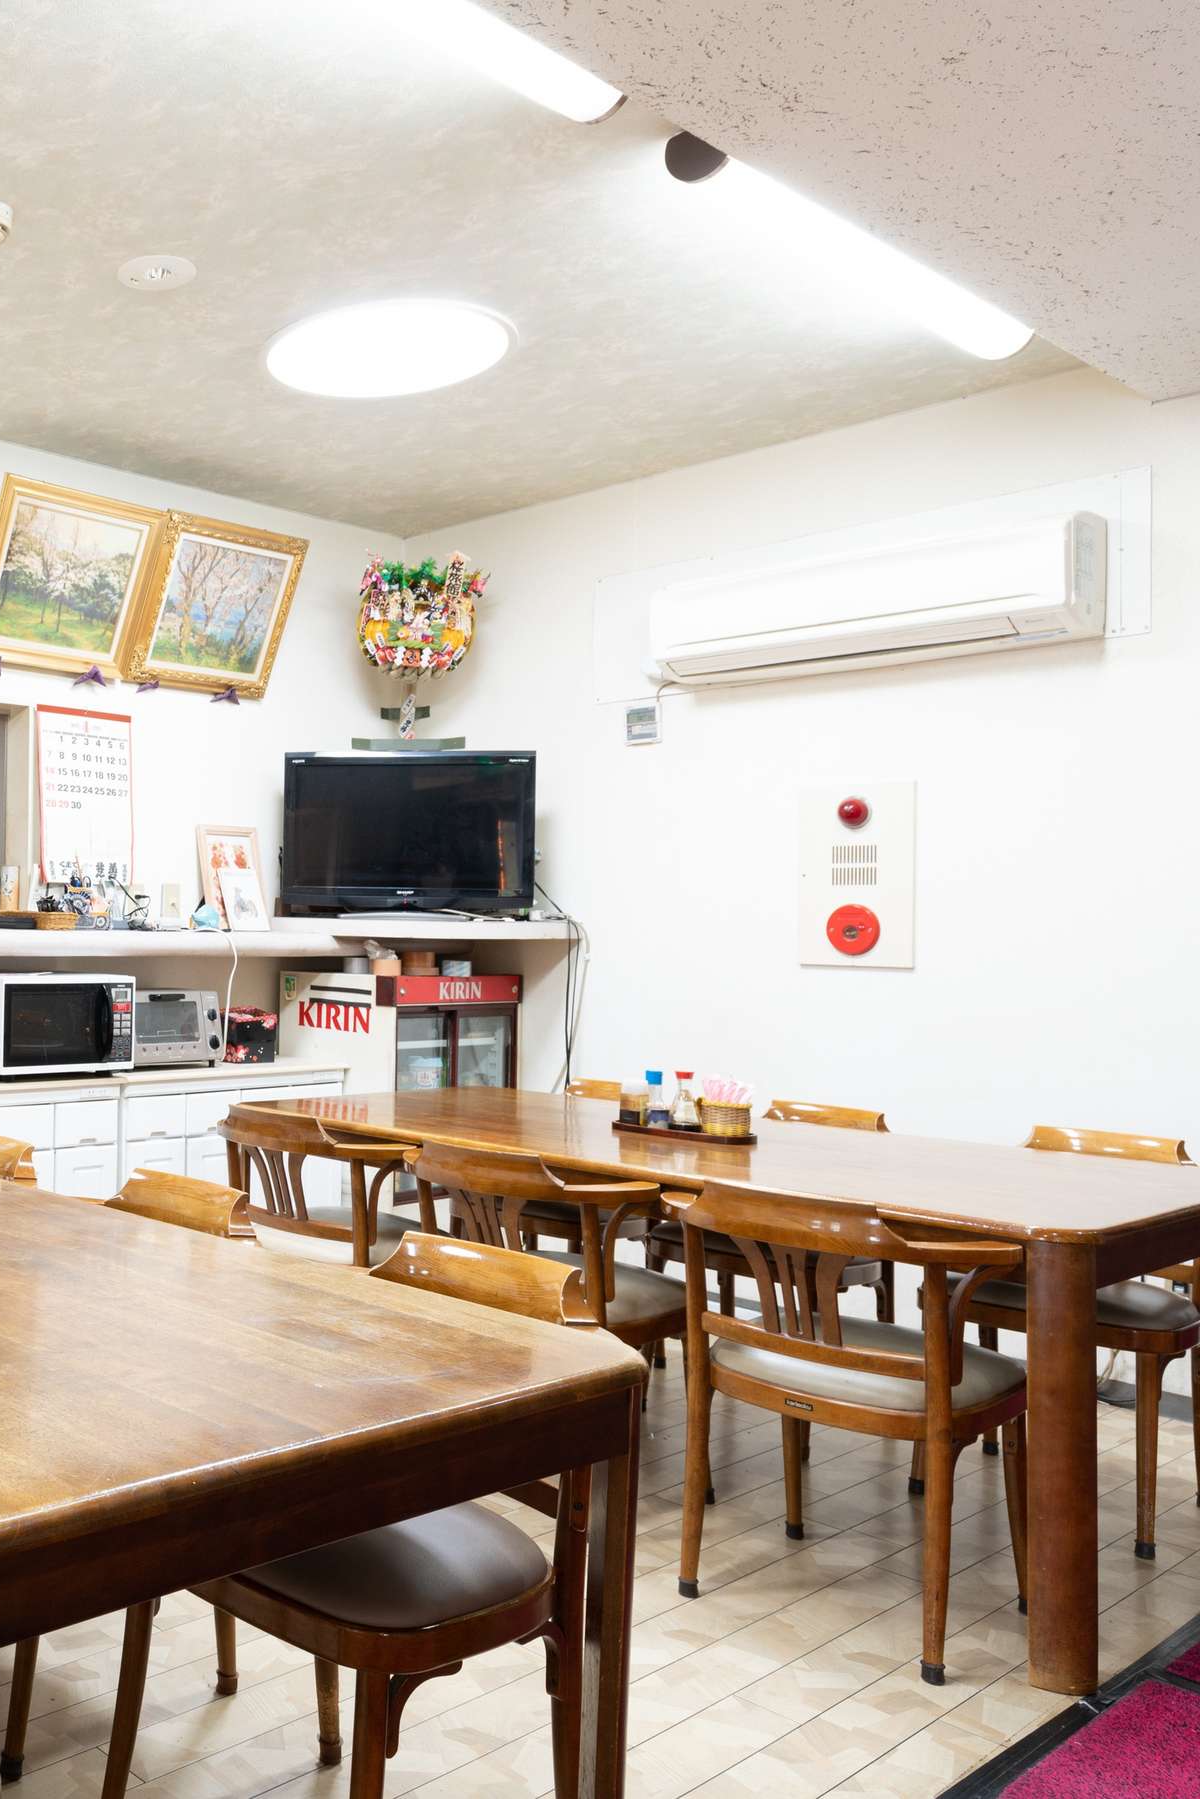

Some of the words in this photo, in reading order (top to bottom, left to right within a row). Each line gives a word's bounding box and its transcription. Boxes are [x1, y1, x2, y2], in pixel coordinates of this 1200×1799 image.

[59, 735, 64, 743] 1
[71, 736, 78, 745] 2
[83, 737, 90, 746] 3
[95, 739, 101, 747] 4
[107, 741, 114, 749] 5
[59, 751, 65, 760] 8
[71, 752, 78, 760] 9
[82, 753, 92, 762] 10
[95, 755, 103, 763] 11
[106, 756, 116, 765] 12
[118, 758, 127, 766] 13
[58, 767, 68, 776] 15
[70, 768, 80, 777] 16
[83, 769, 92, 778] 17
[95, 771, 104, 780] 18
[106, 772, 116, 780] 19
[117, 773, 128, 782] 20
[57, 783, 69, 792] 22
[70, 784, 82, 793] 23
[82, 785, 93, 794] 24
[94, 787, 105, 795] 25
[106, 788, 117, 797] 26
[117, 789, 128, 797] 27
[70, 800, 82, 809] 30
[438, 981, 482, 1000] KIRIN
[297, 1000, 372, 1034] KIRIN
